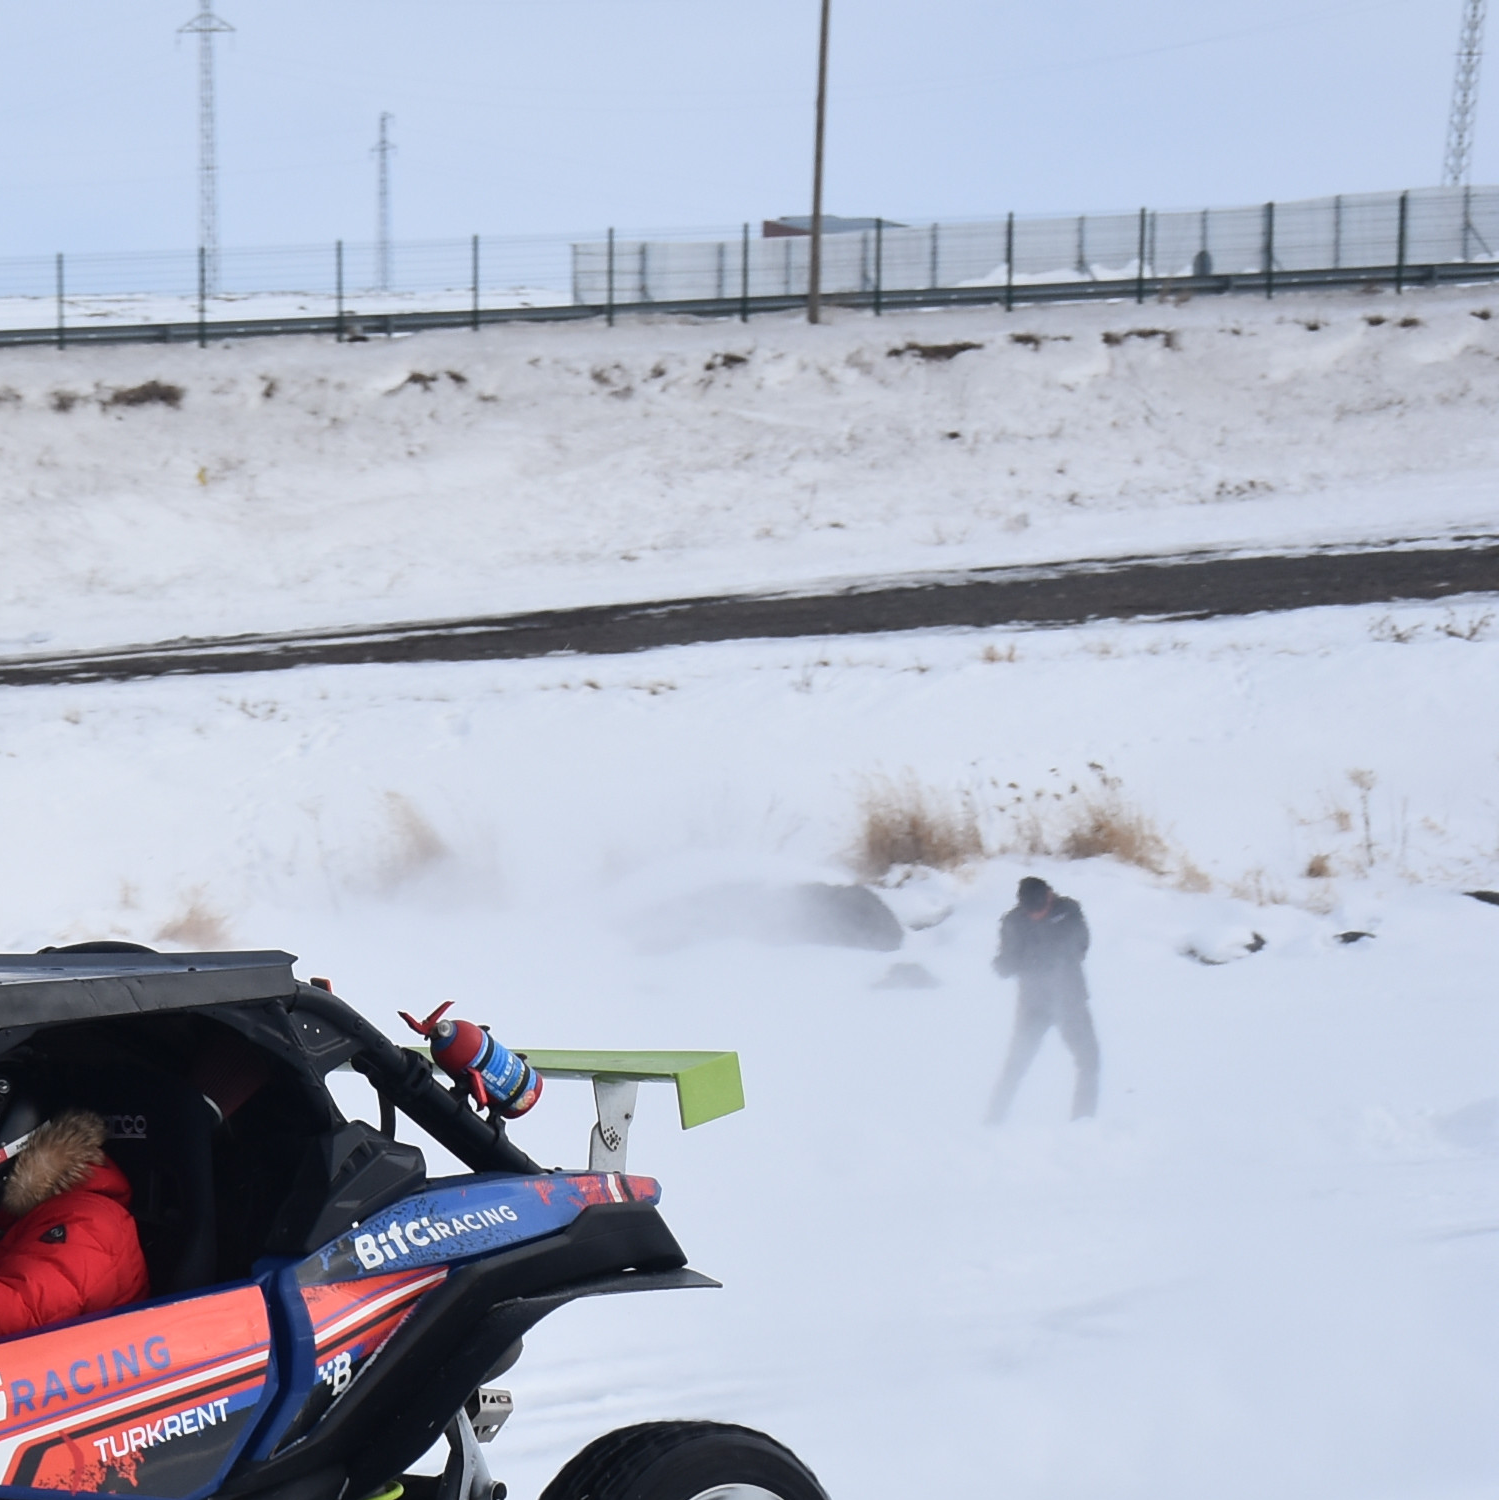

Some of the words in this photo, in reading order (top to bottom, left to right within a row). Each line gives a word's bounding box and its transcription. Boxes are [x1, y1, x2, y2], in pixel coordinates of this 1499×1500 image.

[433, 1205, 519, 1239] RACING
[11, 1335, 173, 1417] RACING
[93, 1397, 230, 1463] TURKRENT
